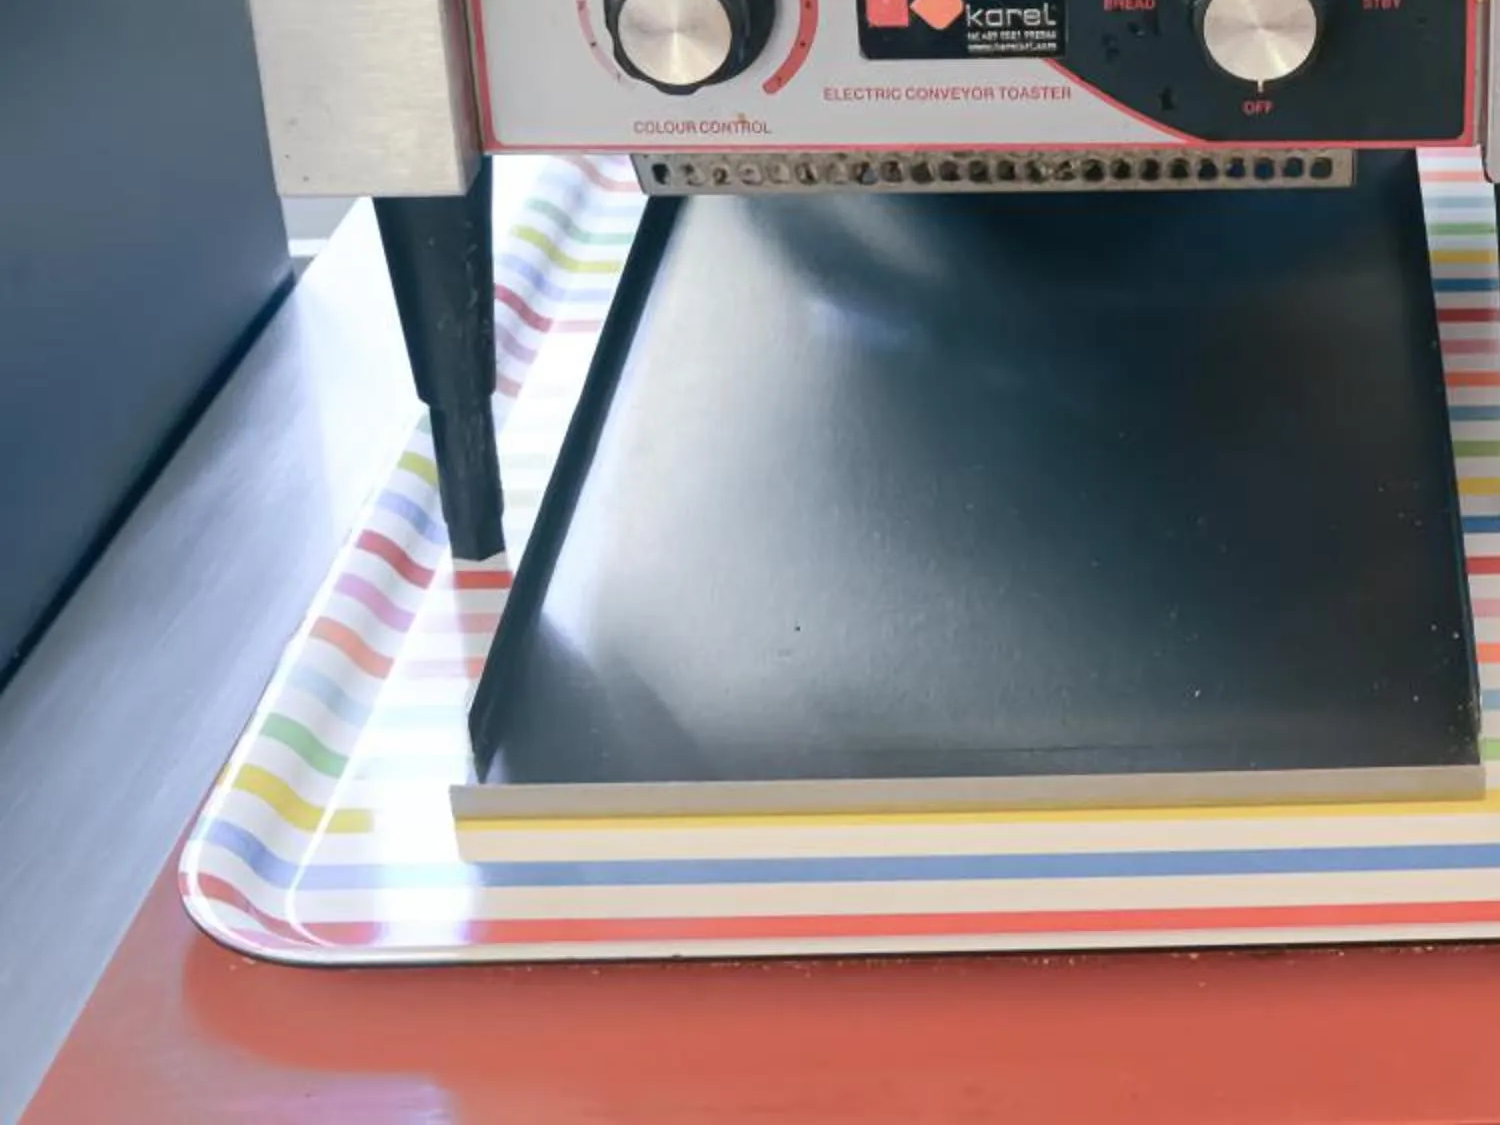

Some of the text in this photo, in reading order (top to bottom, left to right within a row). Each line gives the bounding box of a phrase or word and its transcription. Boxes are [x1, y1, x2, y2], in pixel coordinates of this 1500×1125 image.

[965, 2, 1057, 28] karel
[822, 85, 1072, 102] ELECTRIC CONVEYOR TOASTER
[1242, 100, 1273, 115] OFF
[632, 119, 772, 135] COLOUR CONTROL
